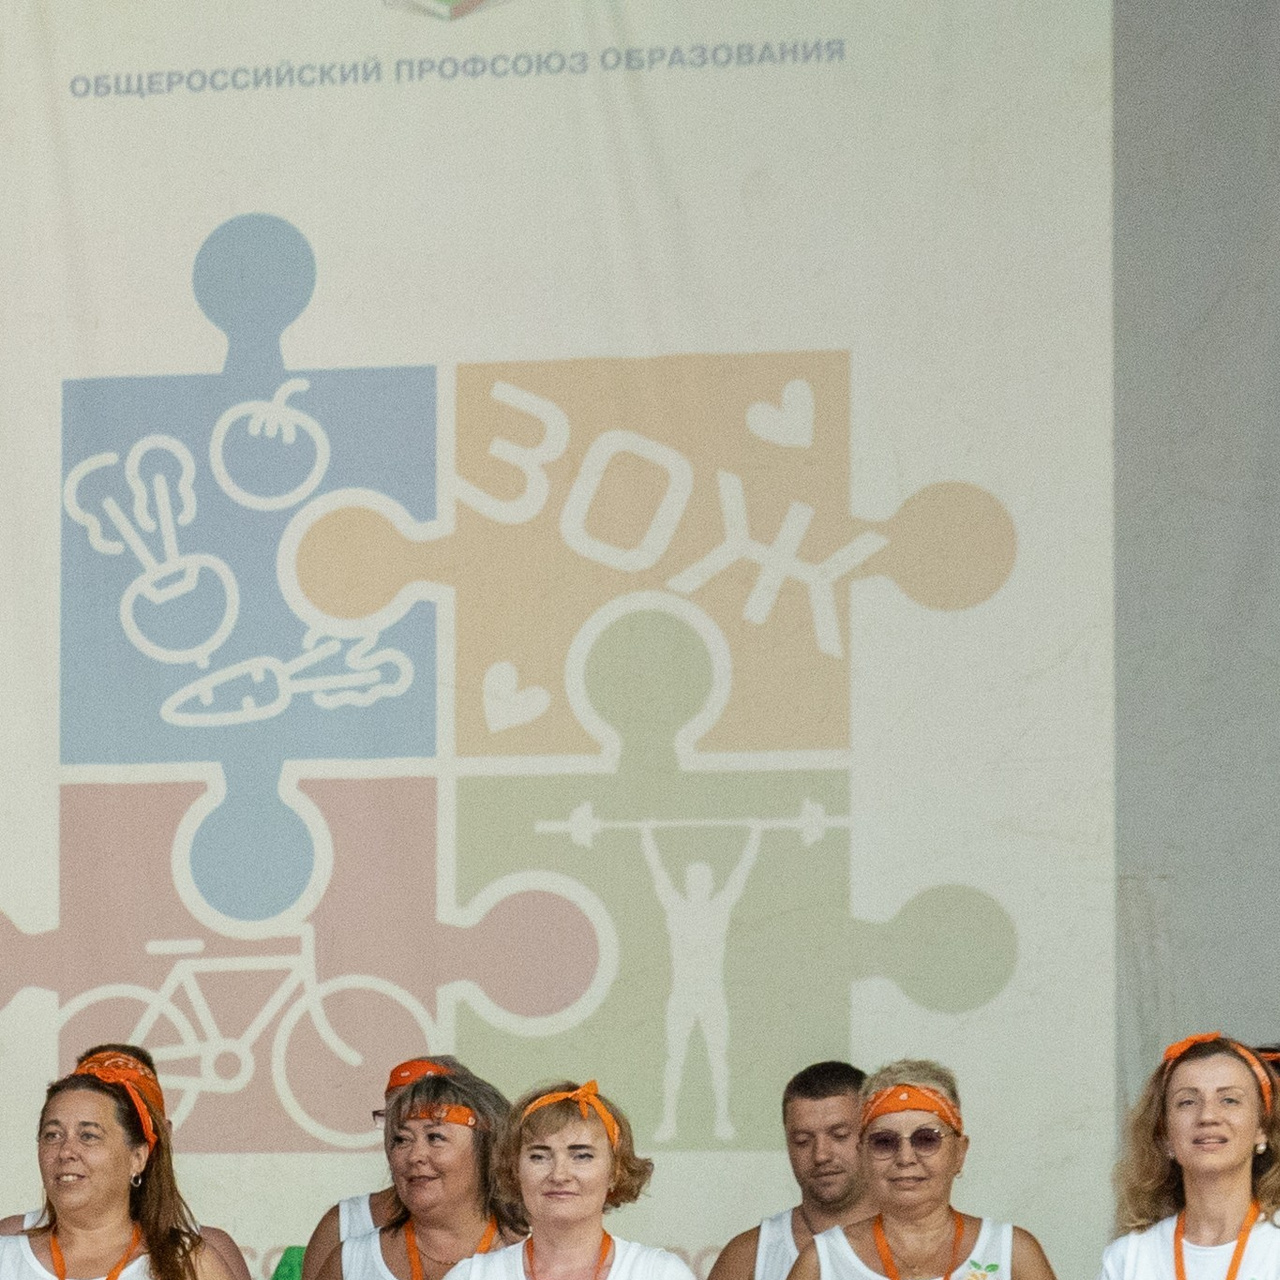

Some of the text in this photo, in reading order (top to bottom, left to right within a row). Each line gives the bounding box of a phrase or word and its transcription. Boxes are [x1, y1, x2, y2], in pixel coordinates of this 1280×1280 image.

[69, 37, 847, 99] ОБЩЕРОССИЙСКИЙ ПРОФСОЮЗ ОБРАЗОВАНИЯ
[454, 379, 891, 660] ЗОЖ
